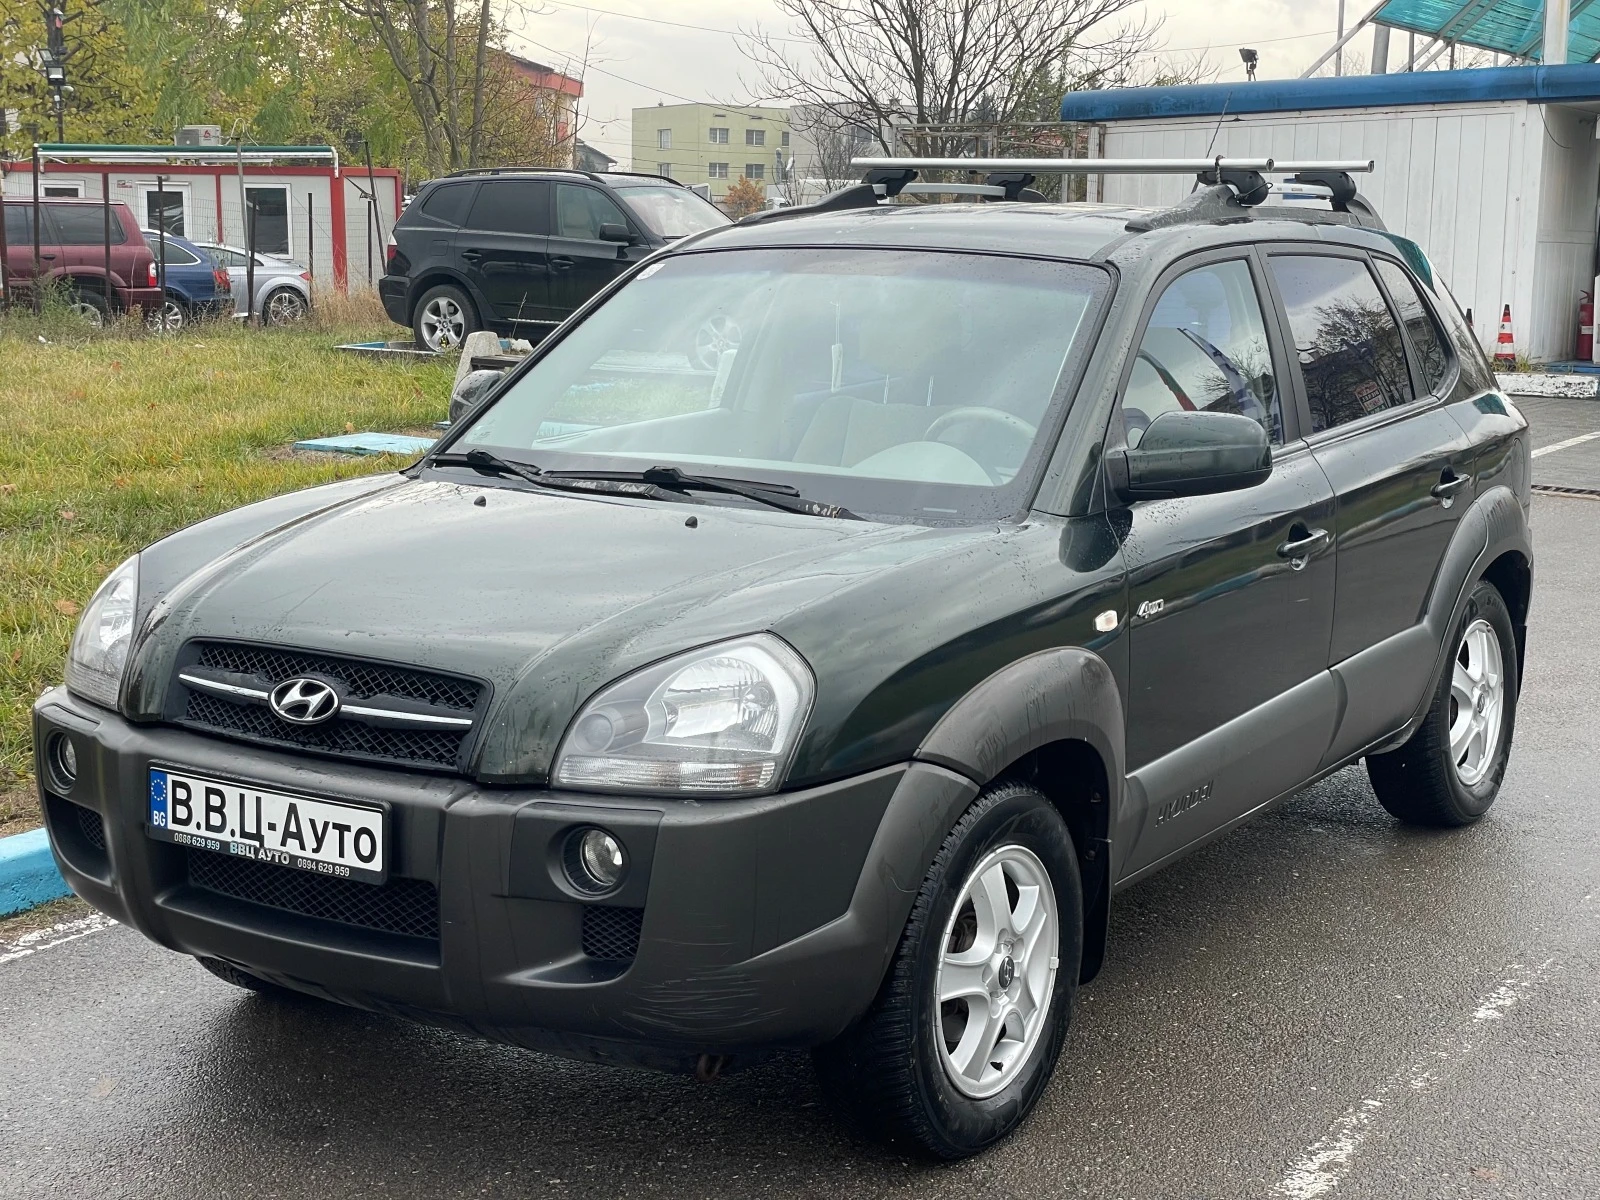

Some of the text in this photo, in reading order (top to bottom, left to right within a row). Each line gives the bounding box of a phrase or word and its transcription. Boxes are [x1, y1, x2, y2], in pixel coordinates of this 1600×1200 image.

[1155, 779, 1215, 828] HYUNDAI
[153, 810, 166, 827] BG
[173, 832, 220, 851] 0888 629 959
[258, 847, 291, 865] АУТО
[297, 858, 350, 877] 0894 629 959
